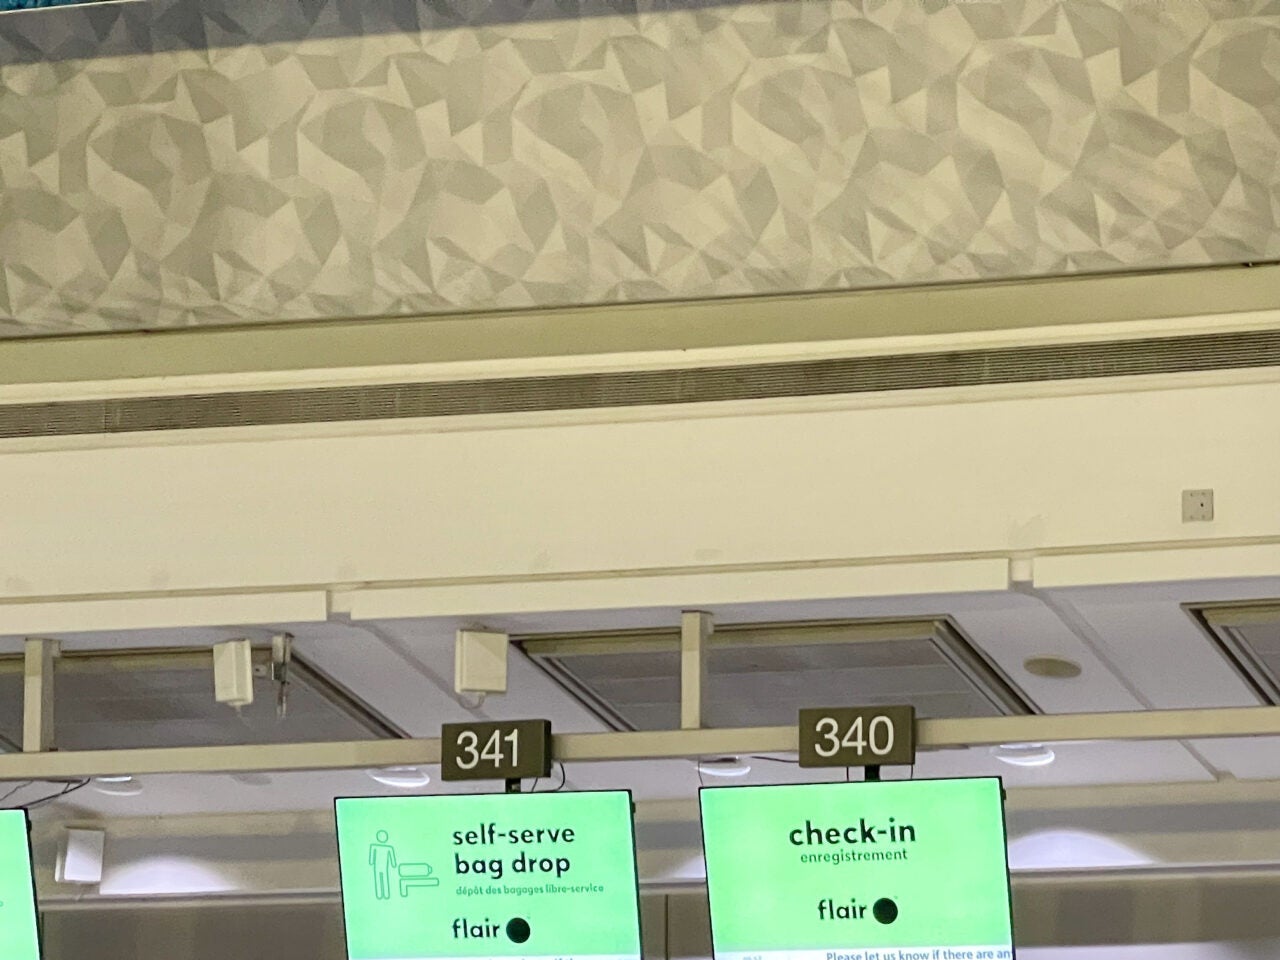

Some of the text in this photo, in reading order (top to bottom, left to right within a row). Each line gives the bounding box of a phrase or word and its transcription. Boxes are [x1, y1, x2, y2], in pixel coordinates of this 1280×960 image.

[813, 716, 895, 756] 340
[455, 729, 520, 769] 341
[453, 823, 575, 845] self-serve
[789, 818, 916, 846] check-in
[455, 852, 570, 879] bag drop
[800, 848, 908, 866] enregistrement
[486, 884, 501, 895] des
[504, 884, 544, 897] bagages
[818, 898, 867, 921] flair
[452, 917, 500, 939] flair
[899, 950, 929, 960] know
[932, 949, 940, 960] if
[943, 949, 973, 960] there
[976, 951, 993, 960] are
